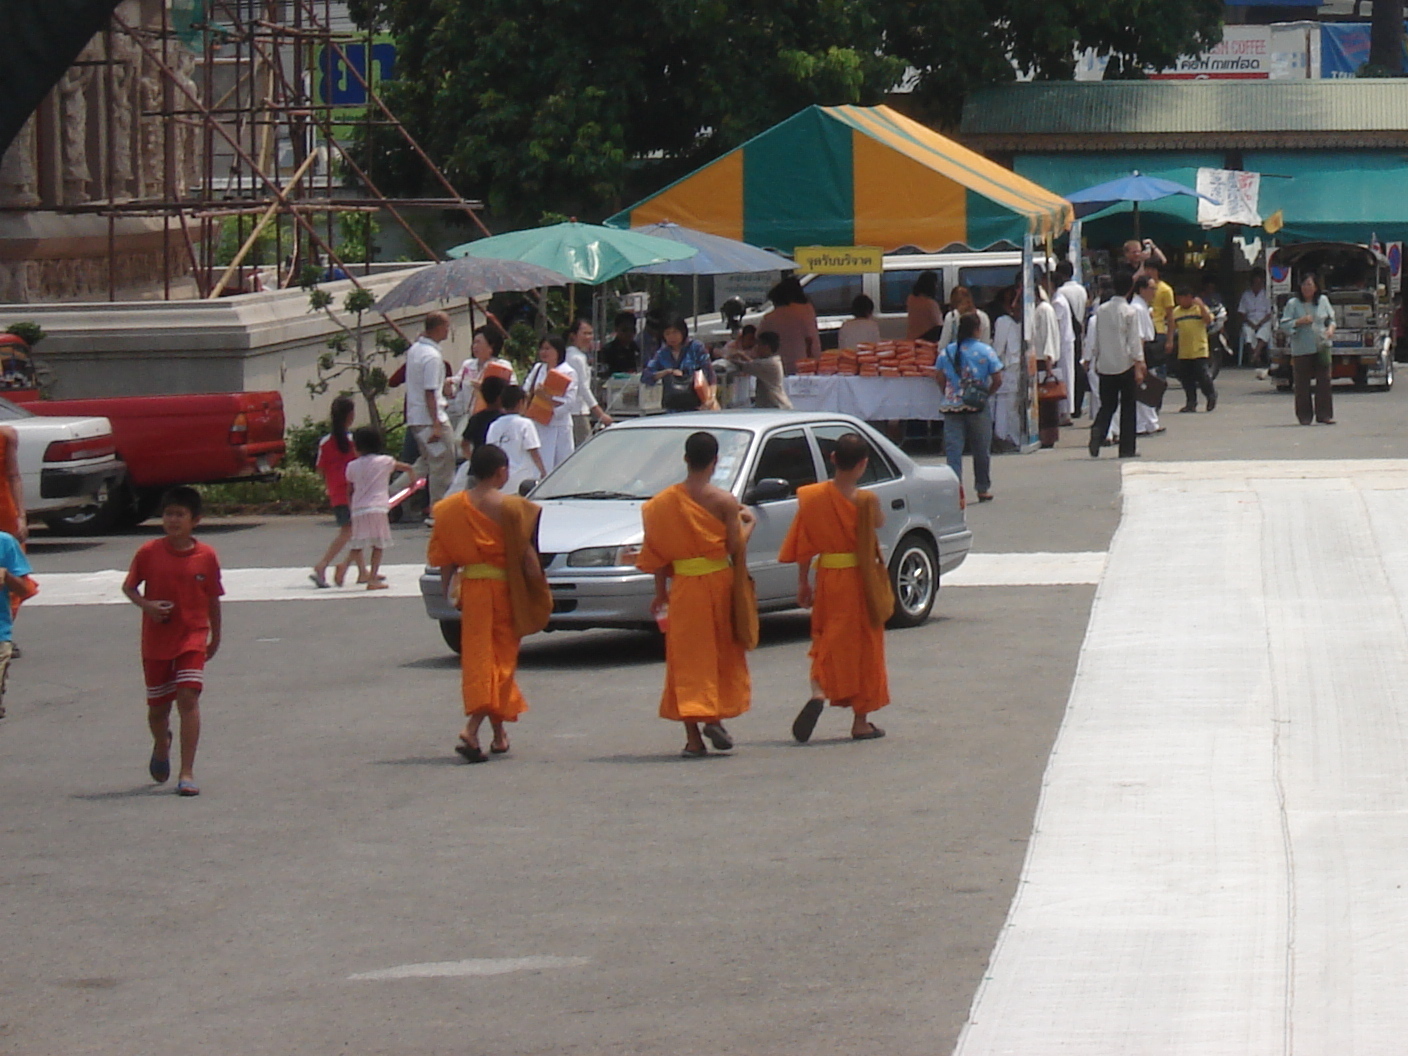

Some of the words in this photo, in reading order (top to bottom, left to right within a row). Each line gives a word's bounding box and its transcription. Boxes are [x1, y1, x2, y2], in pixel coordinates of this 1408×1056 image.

[1232, 40, 1266, 54] COFFEE
[807, 253, 872, 270] จุดรับบริจาค
